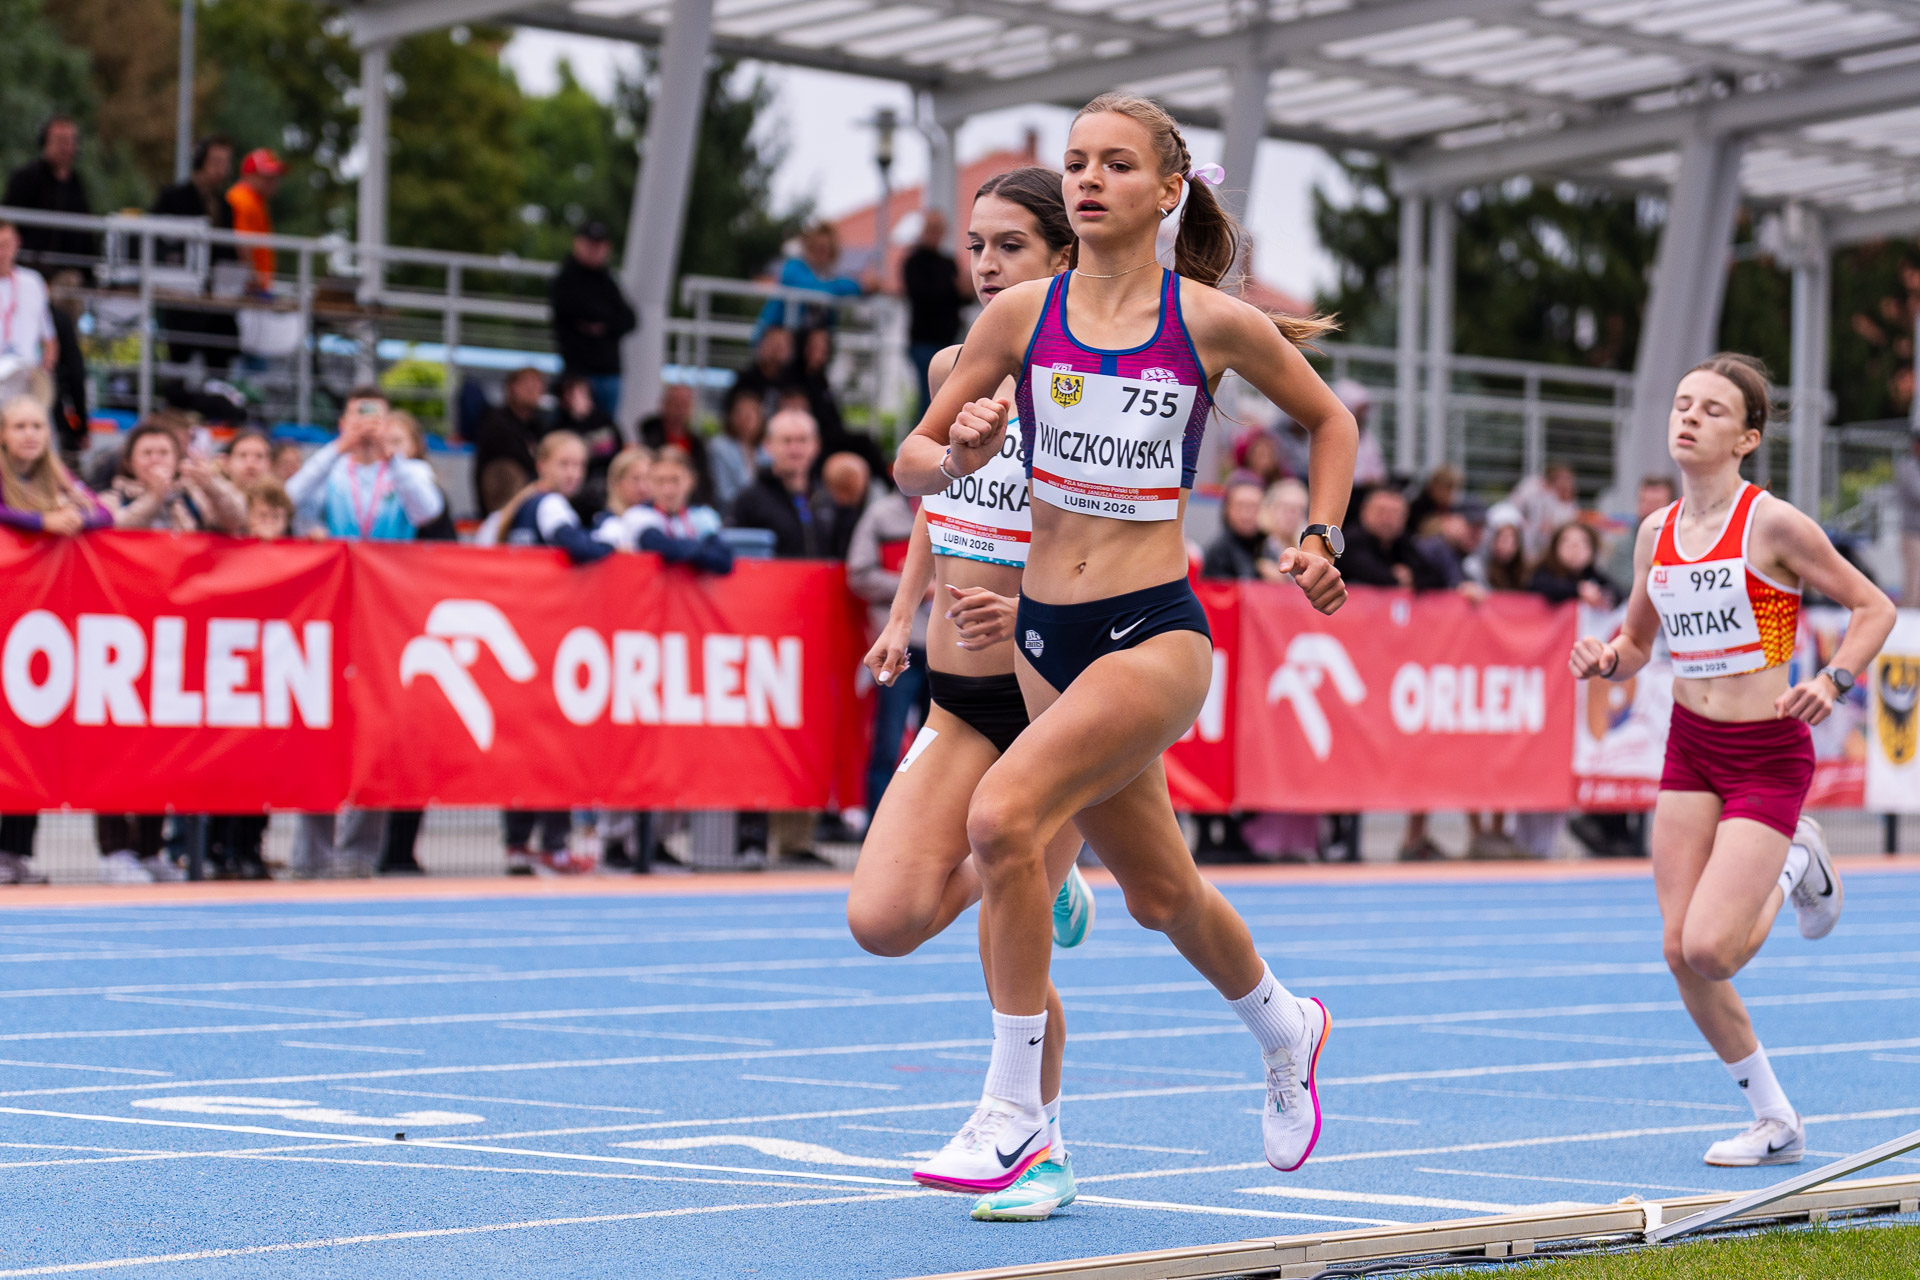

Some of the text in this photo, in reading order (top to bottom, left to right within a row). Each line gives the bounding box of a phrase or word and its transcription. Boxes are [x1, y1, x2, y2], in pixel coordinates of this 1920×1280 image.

[1122, 386, 1179, 419] 755
[995, 434, 1025, 462] 08
[1039, 421, 1175, 470] WICZKOWSKA
[1064, 495, 1136, 515] LUBIN 2026
[943, 532, 995, 552] LUBIN 2026
[1690, 567, 1733, 592] 992
[2, 608, 334, 730] ORLEN
[552, 626, 804, 730] ORLEN
[1390, 661, 1546, 735] ORLEN
